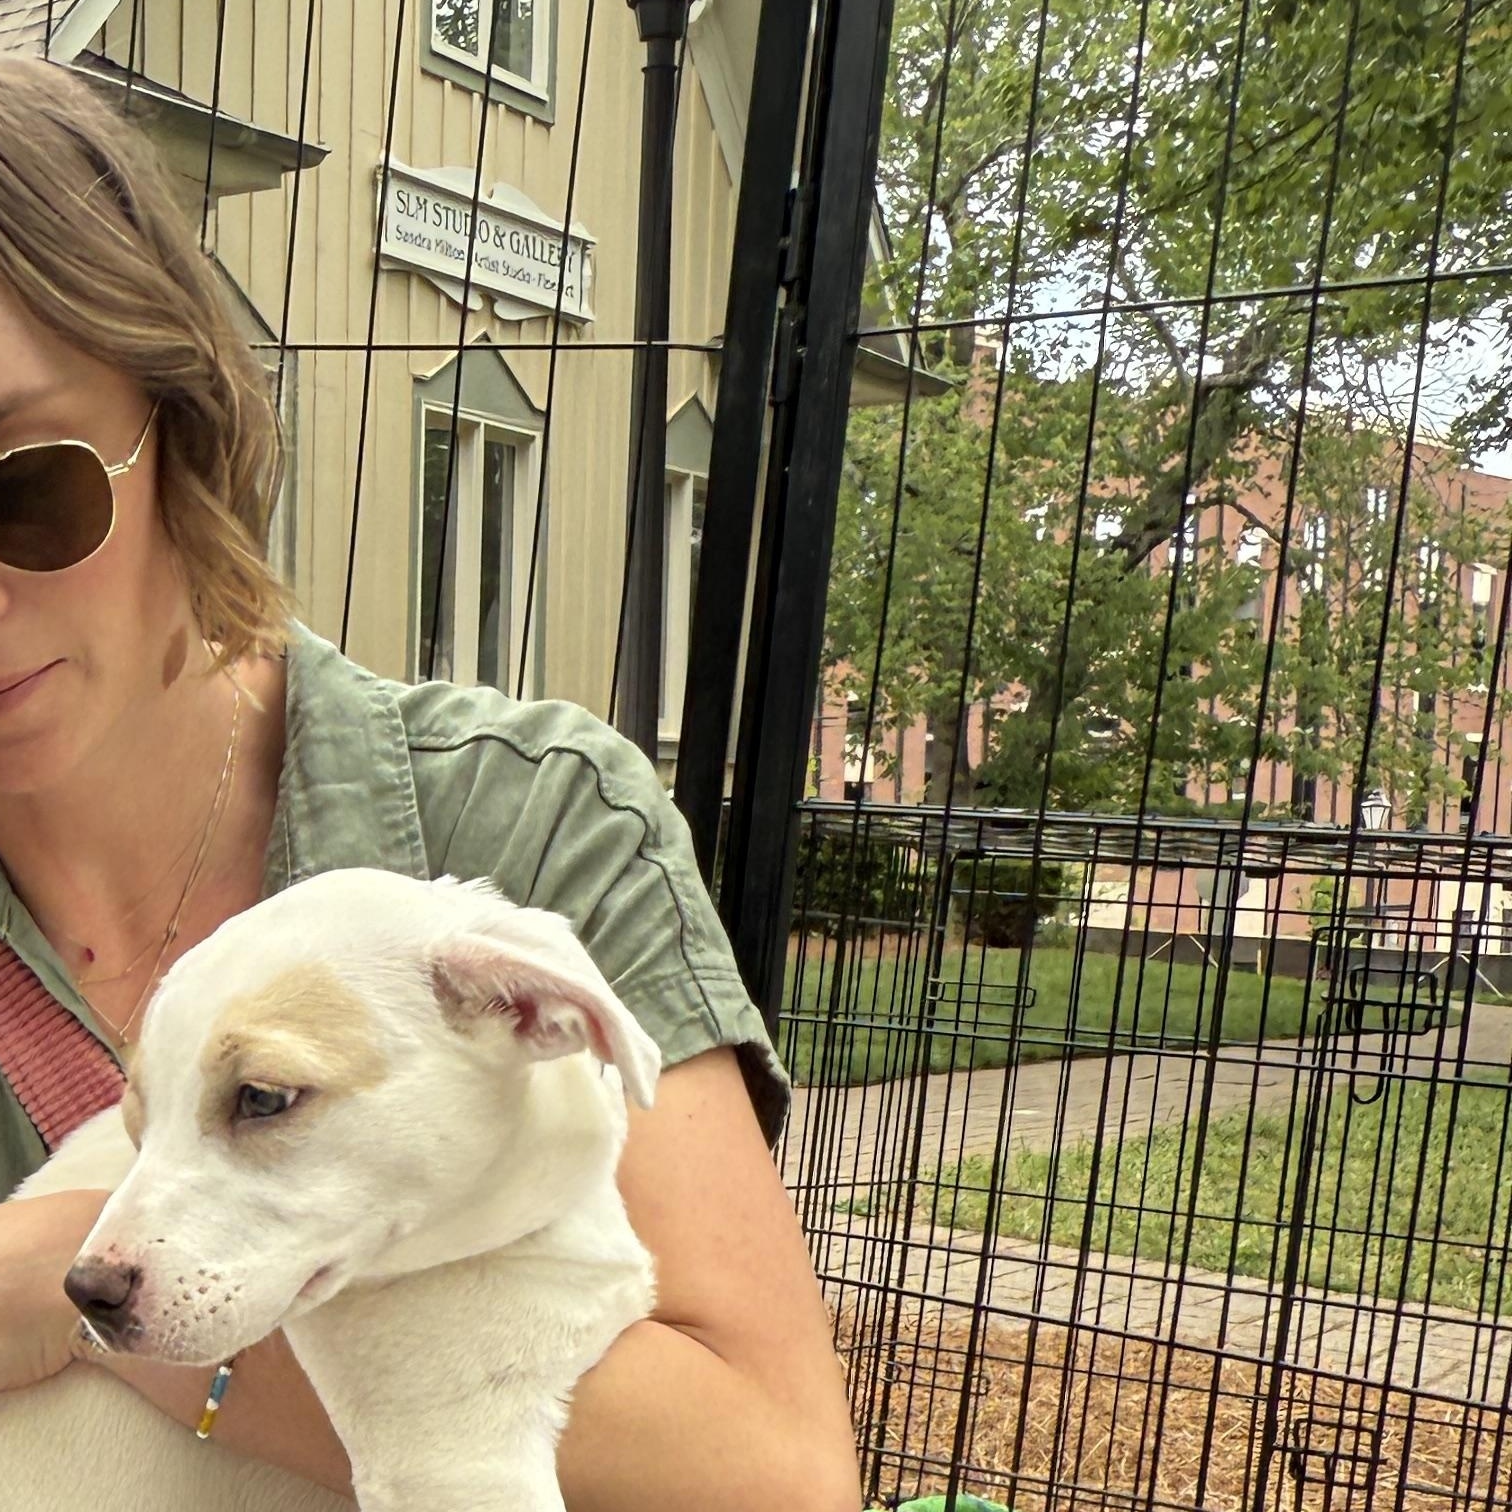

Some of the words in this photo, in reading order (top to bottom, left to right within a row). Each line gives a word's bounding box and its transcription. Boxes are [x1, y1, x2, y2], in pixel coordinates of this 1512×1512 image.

[396, 189, 428, 223] SLM
[432, 202, 490, 243] STUDO
[493, 224, 506, 250] &
